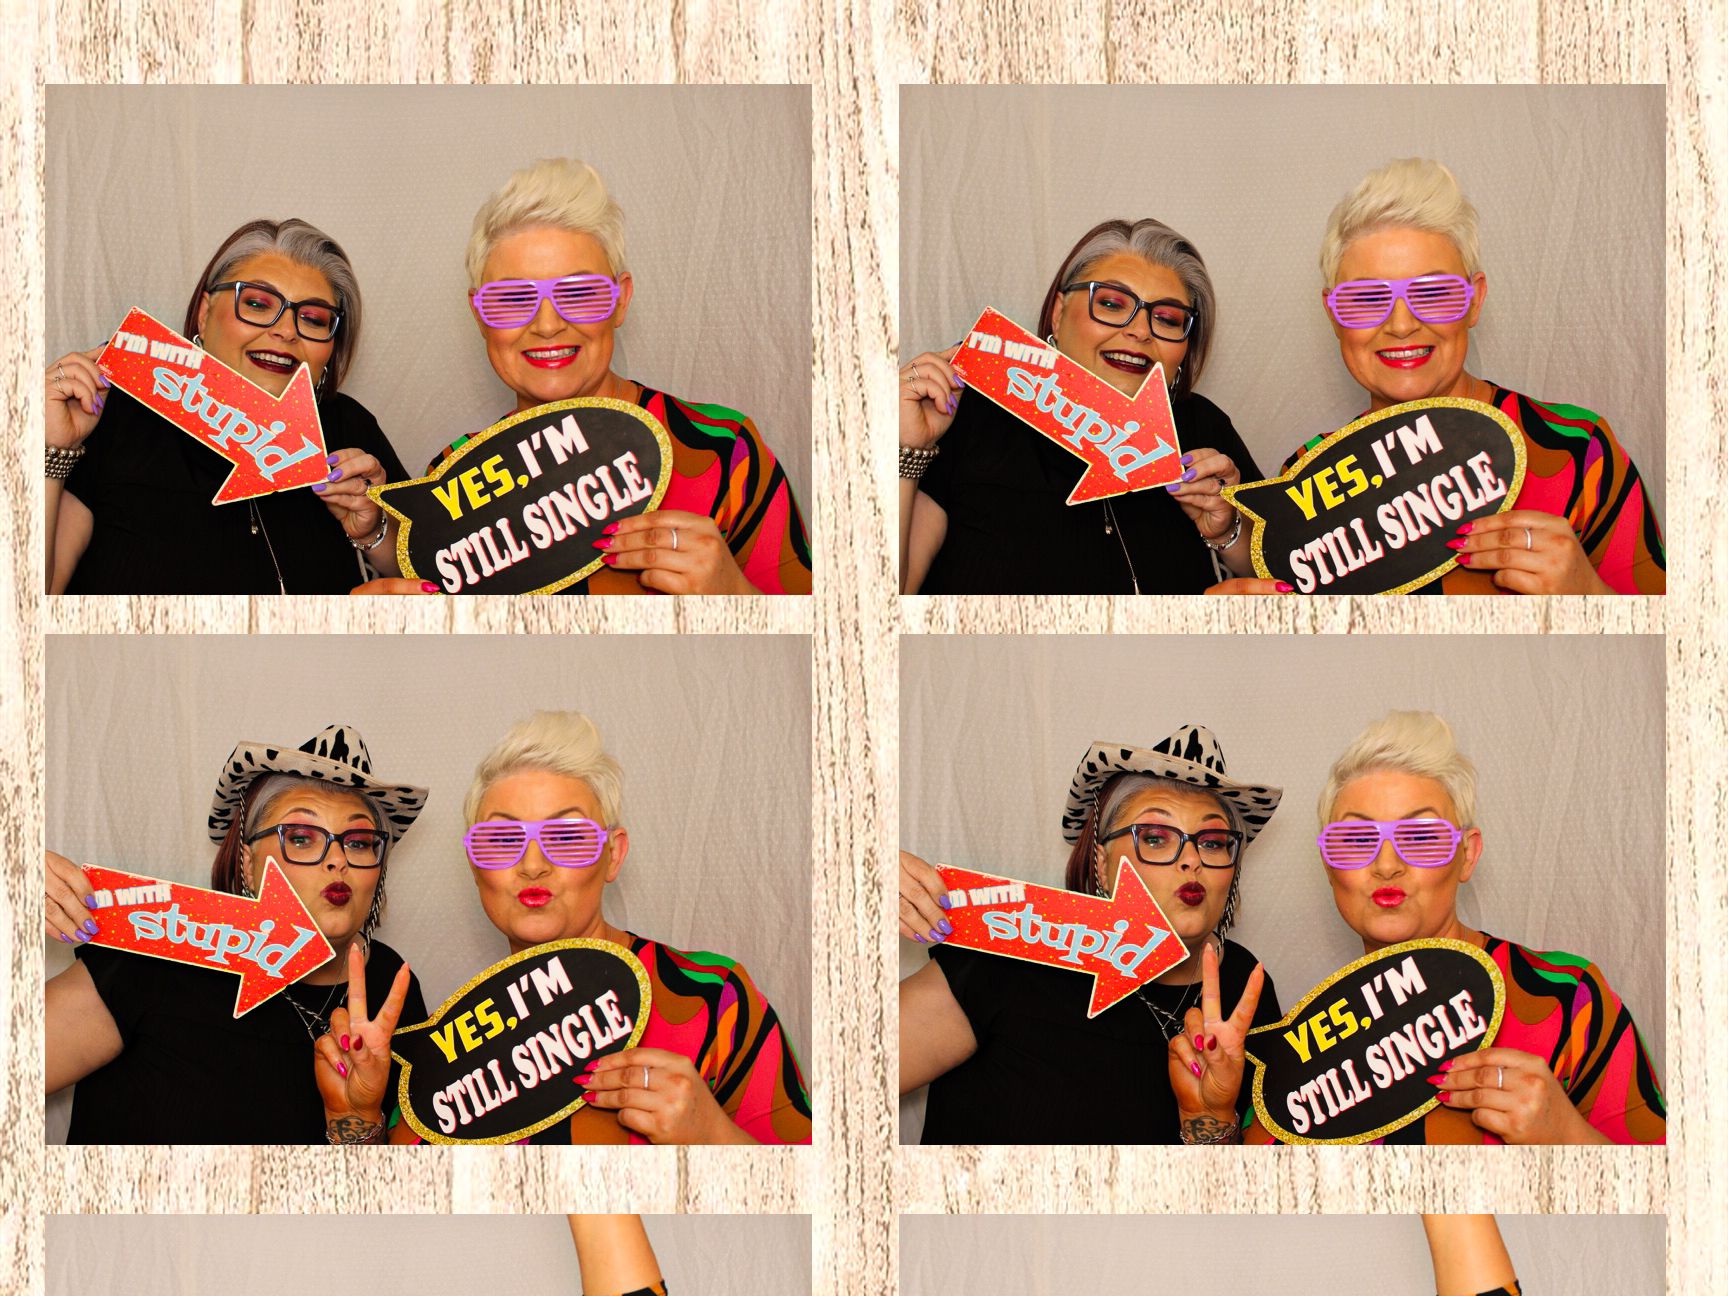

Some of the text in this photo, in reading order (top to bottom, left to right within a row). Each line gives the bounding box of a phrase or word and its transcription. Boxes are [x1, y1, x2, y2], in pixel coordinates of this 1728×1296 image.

[150, 340, 202, 370] WITH
[1004, 340, 1056, 370] WITH
[152, 367, 322, 482] stupid
[431, 414, 589, 520] YES, I'M
[1006, 367, 1176, 482] stupid
[1285, 414, 1443, 520] YES, I'M
[435, 451, 652, 593] STILL SINGLE
[1289, 451, 1506, 593] STILL SINGLE
[115, 884, 172, 906] WITH
[128, 904, 316, 977] stupid
[969, 884, 1026, 906] WITH
[982, 904, 1170, 977] stupid
[429, 956, 574, 1063] YES, I'M
[432, 990, 632, 1134] STILL SINGLE
[1283, 956, 1428, 1063] YES, I'M
[1286, 990, 1486, 1134] STILL SINGLE
